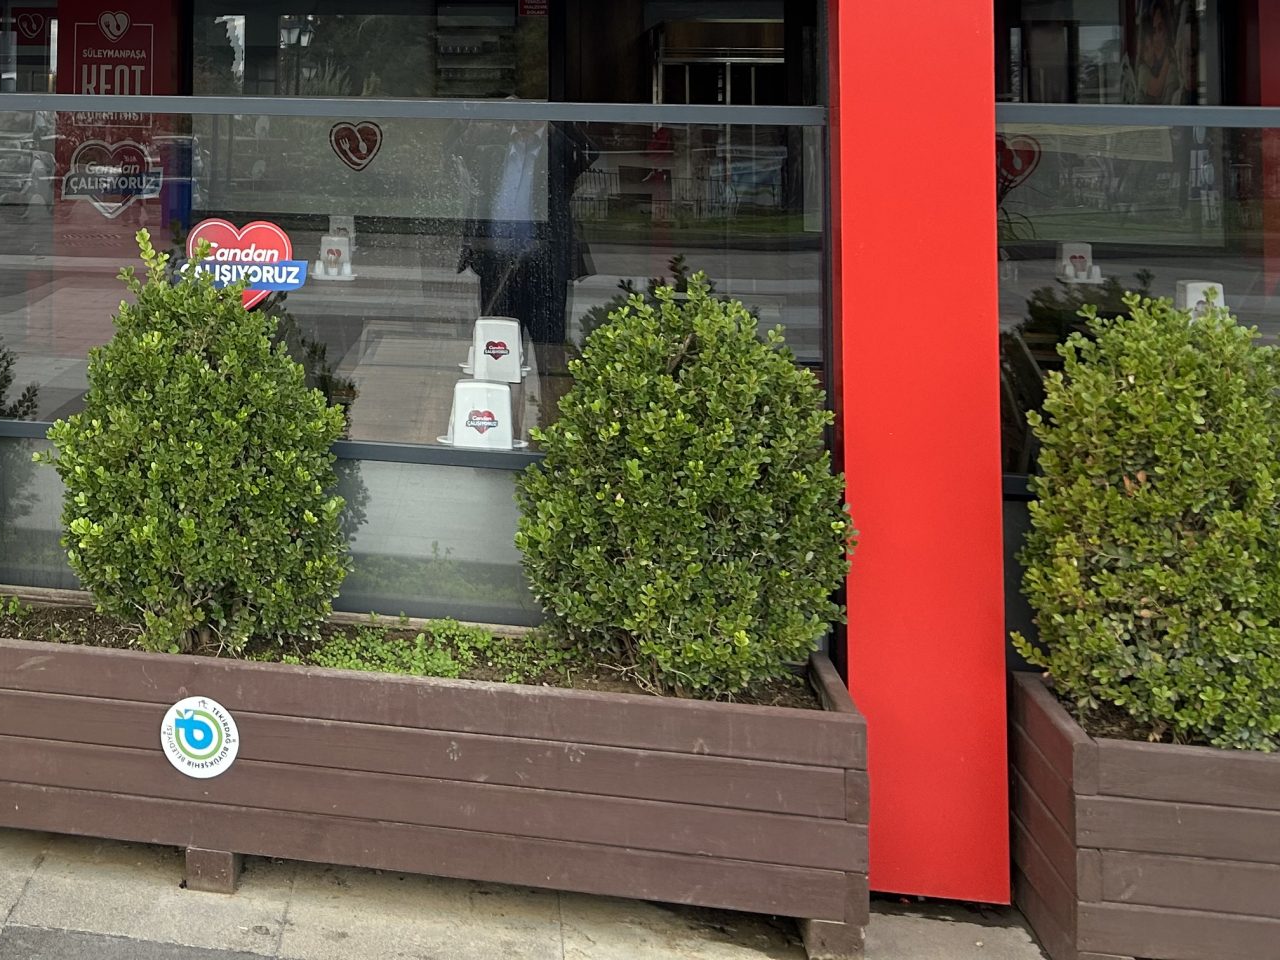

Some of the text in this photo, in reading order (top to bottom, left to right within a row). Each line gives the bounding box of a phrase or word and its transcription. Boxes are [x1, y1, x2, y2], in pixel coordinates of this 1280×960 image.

[82, 49, 146, 60] SÜLEYMANPAŞA
[85, 161, 140, 175] Candan
[70, 176, 156, 194] ÇALIŞIYORUZ
[204, 242, 279, 262] Candan
